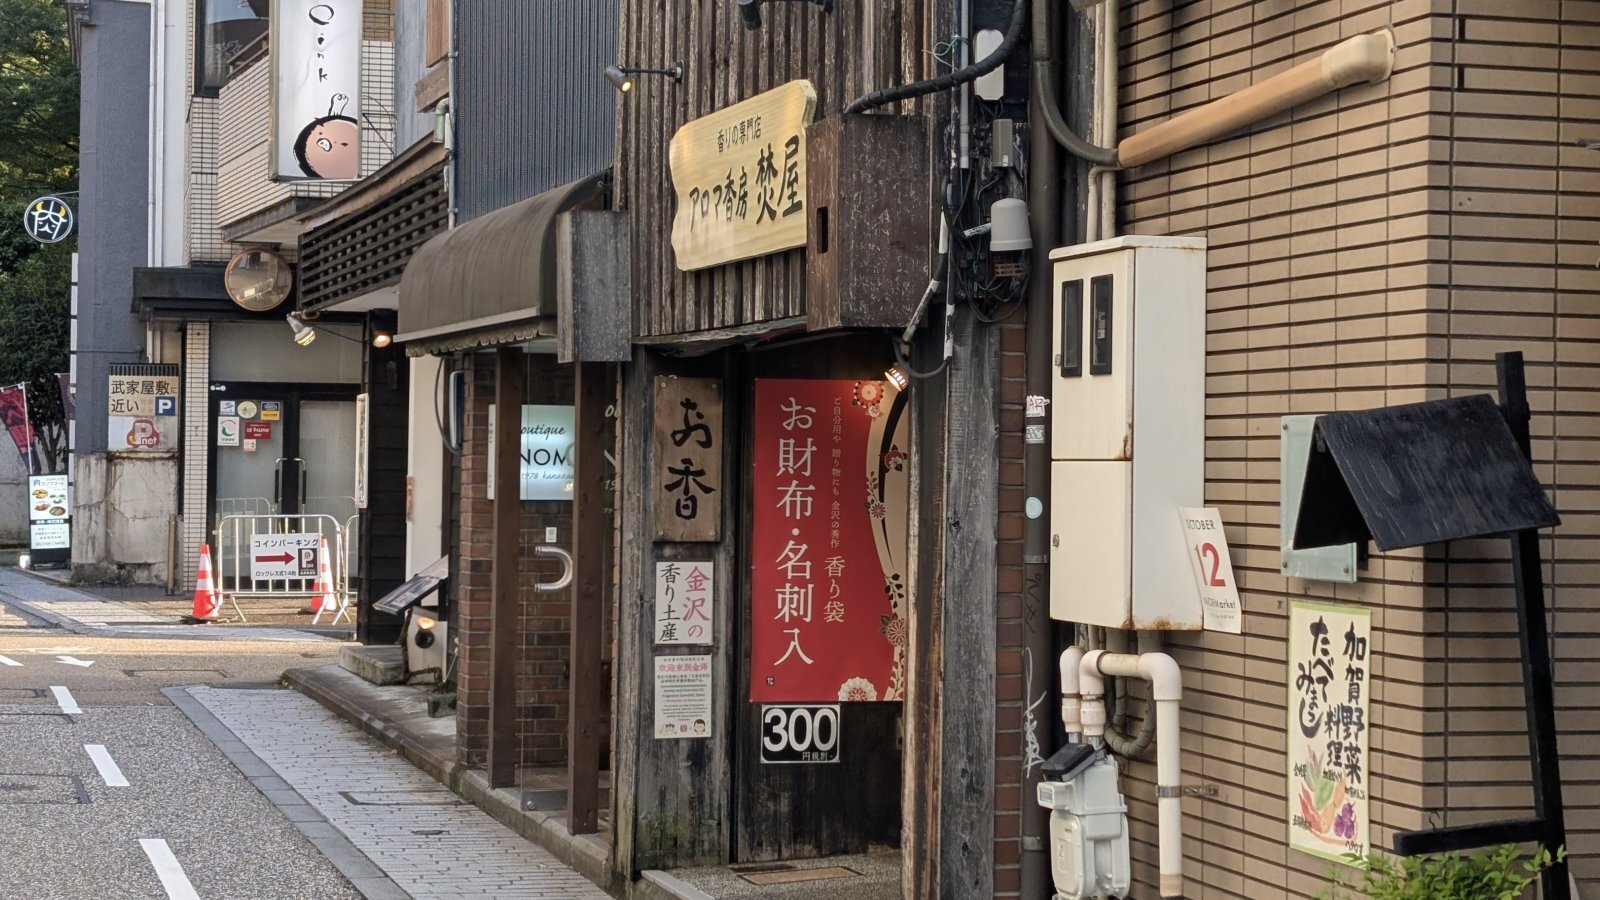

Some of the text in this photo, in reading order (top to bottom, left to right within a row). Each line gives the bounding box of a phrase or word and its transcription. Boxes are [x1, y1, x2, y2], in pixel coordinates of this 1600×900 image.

[716, 114, 762, 153] 香りの専門店
[689, 134, 803, 232] アロマ香房 焚屋
[111, 380, 177, 395] 武家屋敷に
[111, 398, 139, 413] 近い
[158, 399, 172, 413] P
[521, 424, 566, 440] outique
[664, 397, 717, 520] お香
[823, 556, 846, 623] 香り袋
[1194, 542, 1226, 587] 12
[658, 563, 681, 642] 香り土産
[682, 565, 712, 638] 金沢の
[763, 708, 837, 752] 300
[1343, 620, 1366, 785] 加賀野菜
[1324, 703, 1344, 768] 料理
